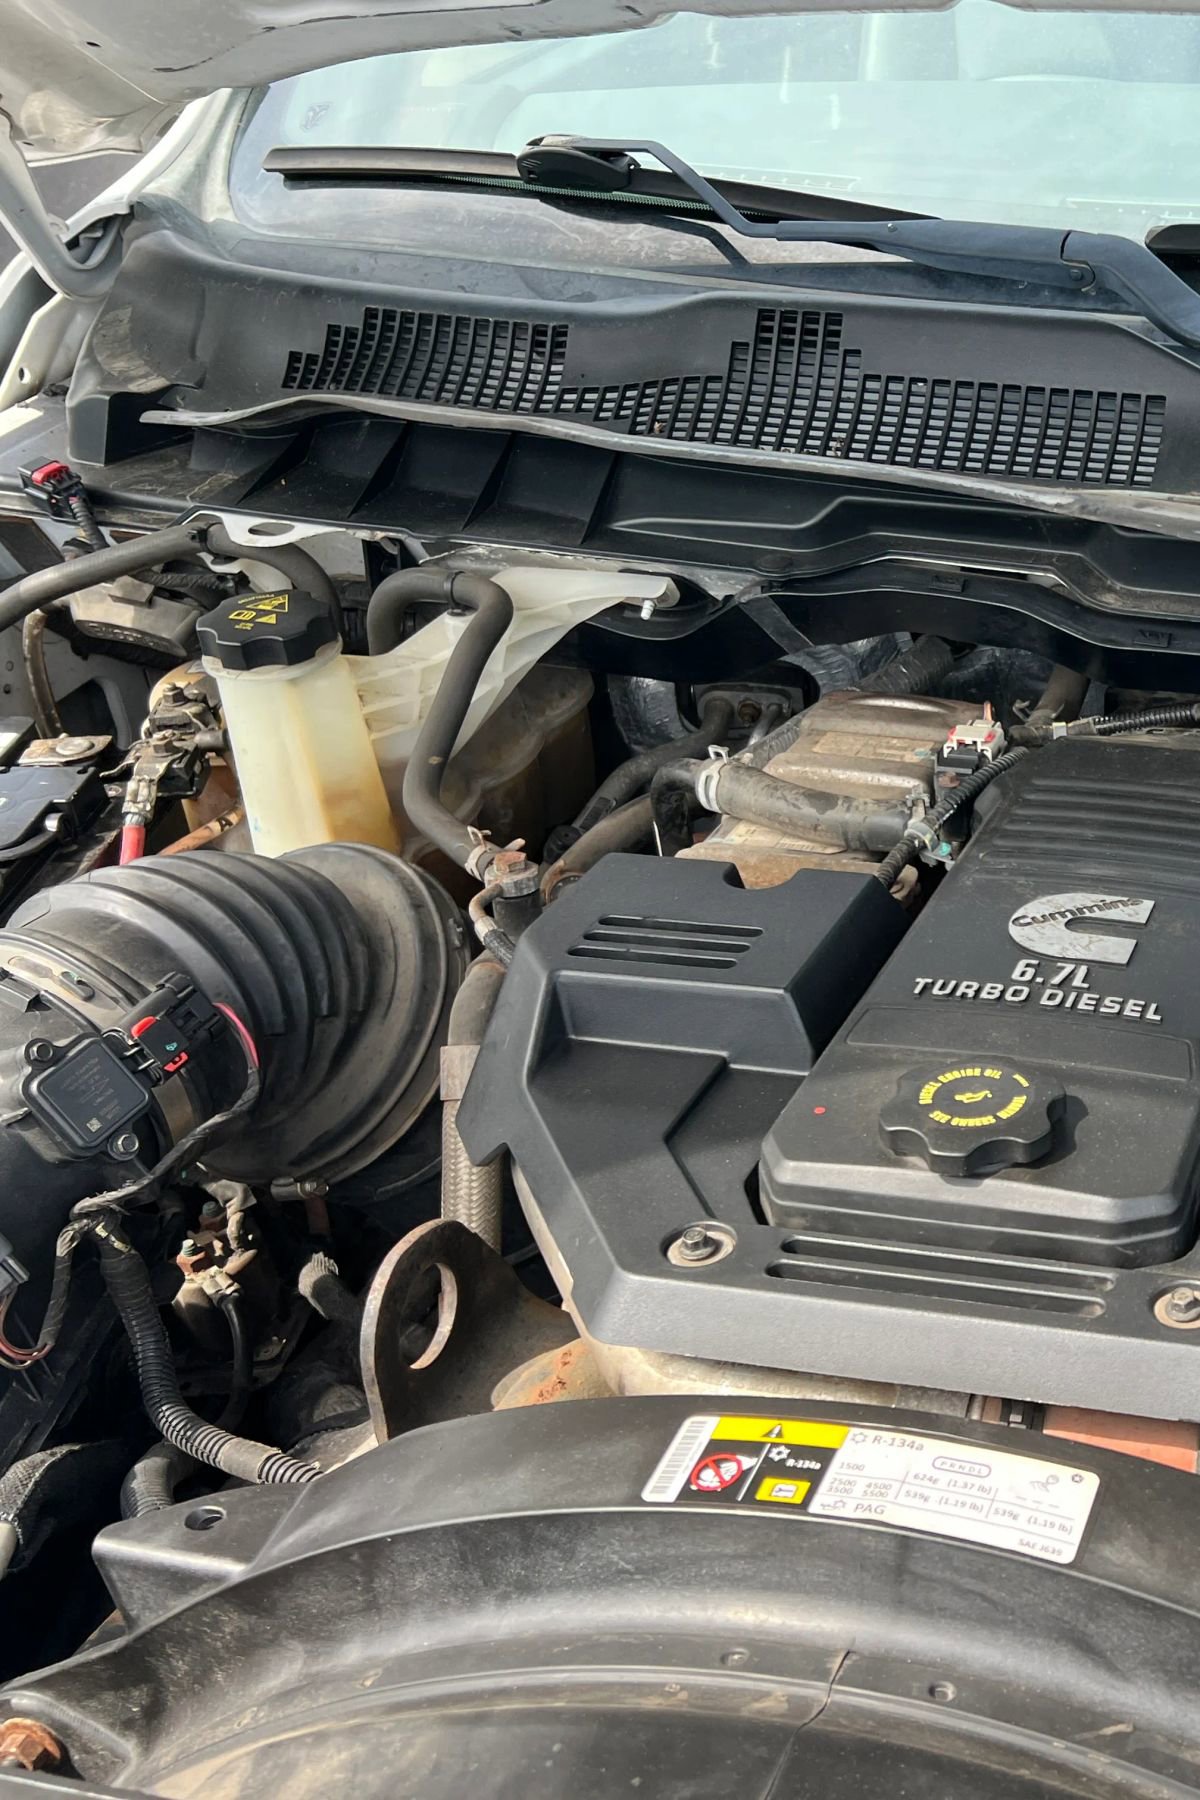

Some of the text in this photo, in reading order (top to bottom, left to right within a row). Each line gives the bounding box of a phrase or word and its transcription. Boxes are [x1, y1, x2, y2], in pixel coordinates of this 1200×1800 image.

[1011, 897, 1144, 928] Cummins
[1011, 958, 1091, 989] 6.7L
[913, 978, 1163, 1022] TURBO DIESEL
[937, 1067, 982, 1083] ENGINE
[983, 1068, 1002, 1080] OIL
[928, 1110, 952, 1124] SEE
[871, 1435, 924, 1451] R-134a
[839, 1461, 866, 1471] 1500
[826, 1485, 889, 1498] 3500 5500
[830, 1477, 893, 1490] 2500 4500
[913, 1472, 993, 1496] 624g (1.37 lb)
[853, 1503, 887, 1515] PAG
[904, 1489, 985, 1513] 539g (1.19 lb)
[993, 1507, 1074, 1535] 539g (1.19 lb)
[1017, 1537, 1063, 1557] SAE J639
